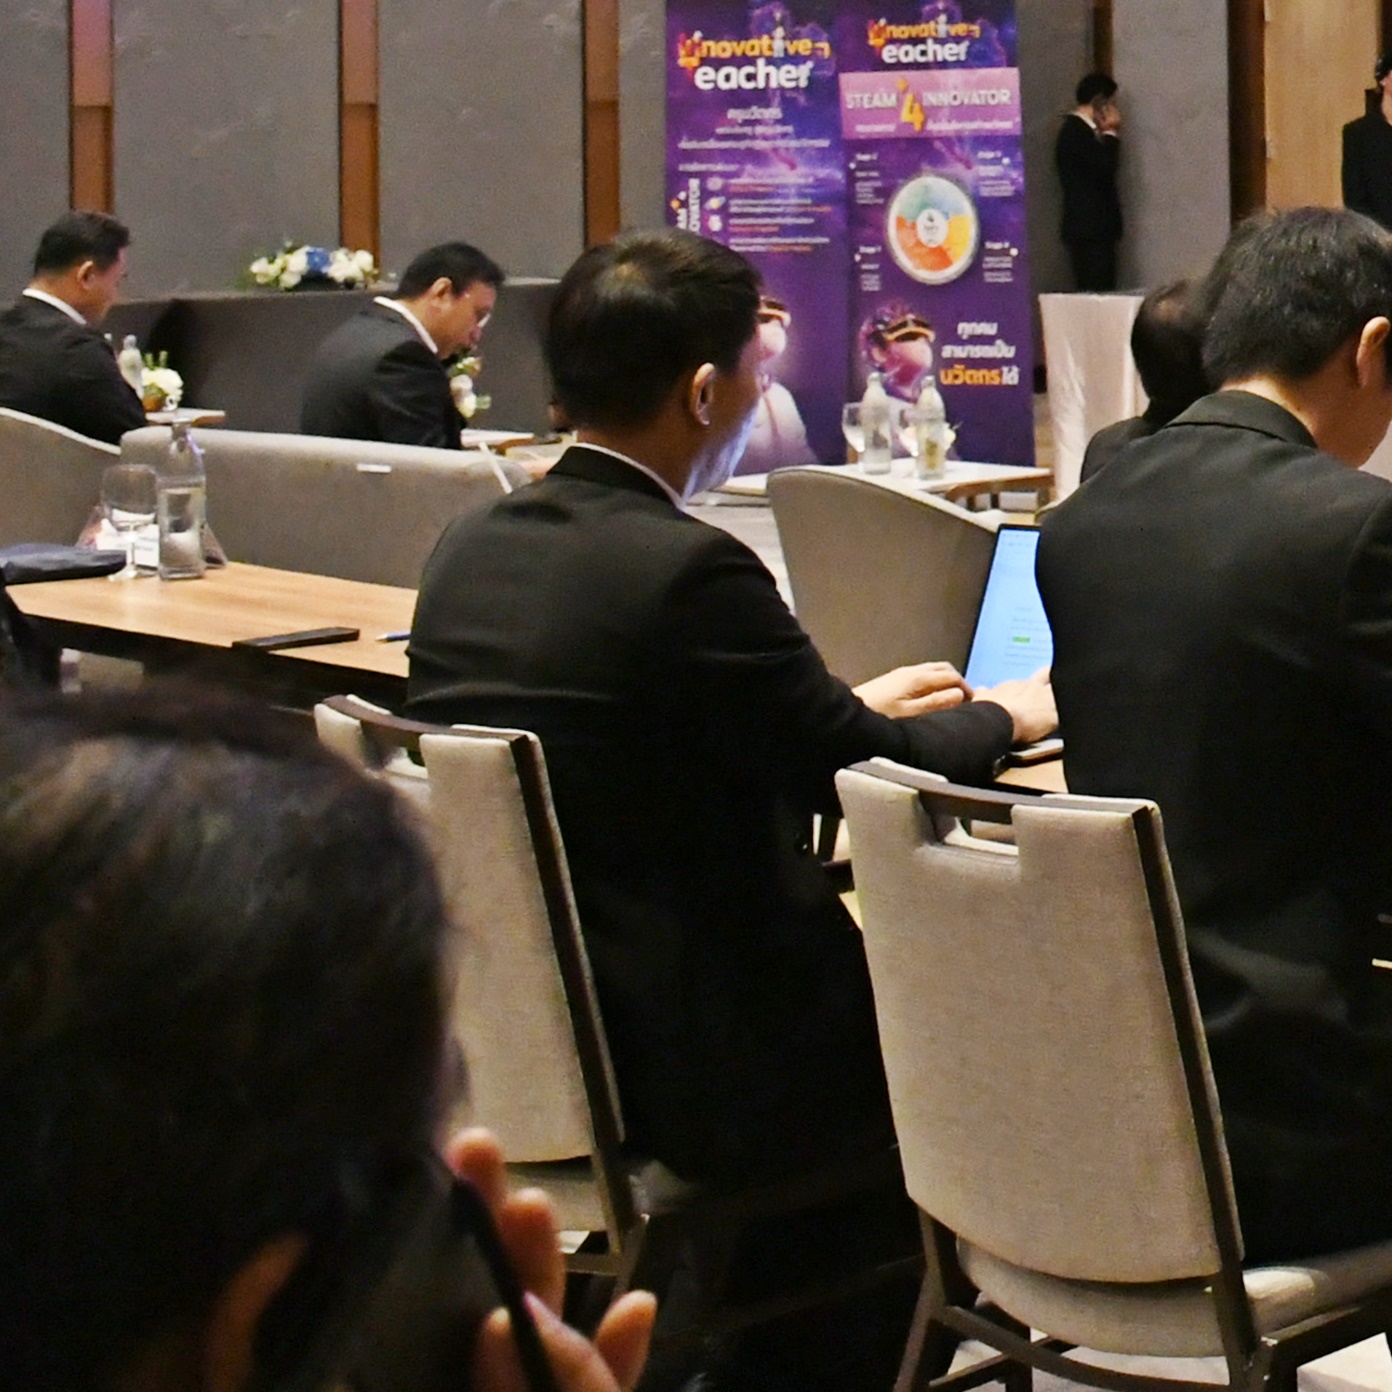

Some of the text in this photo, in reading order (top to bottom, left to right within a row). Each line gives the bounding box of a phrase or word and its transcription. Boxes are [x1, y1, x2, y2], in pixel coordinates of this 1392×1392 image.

[846, 92, 897, 109] STEAM
[901, 93, 925, 131] 4
[922, 89, 1012, 107] INNOVATOR
